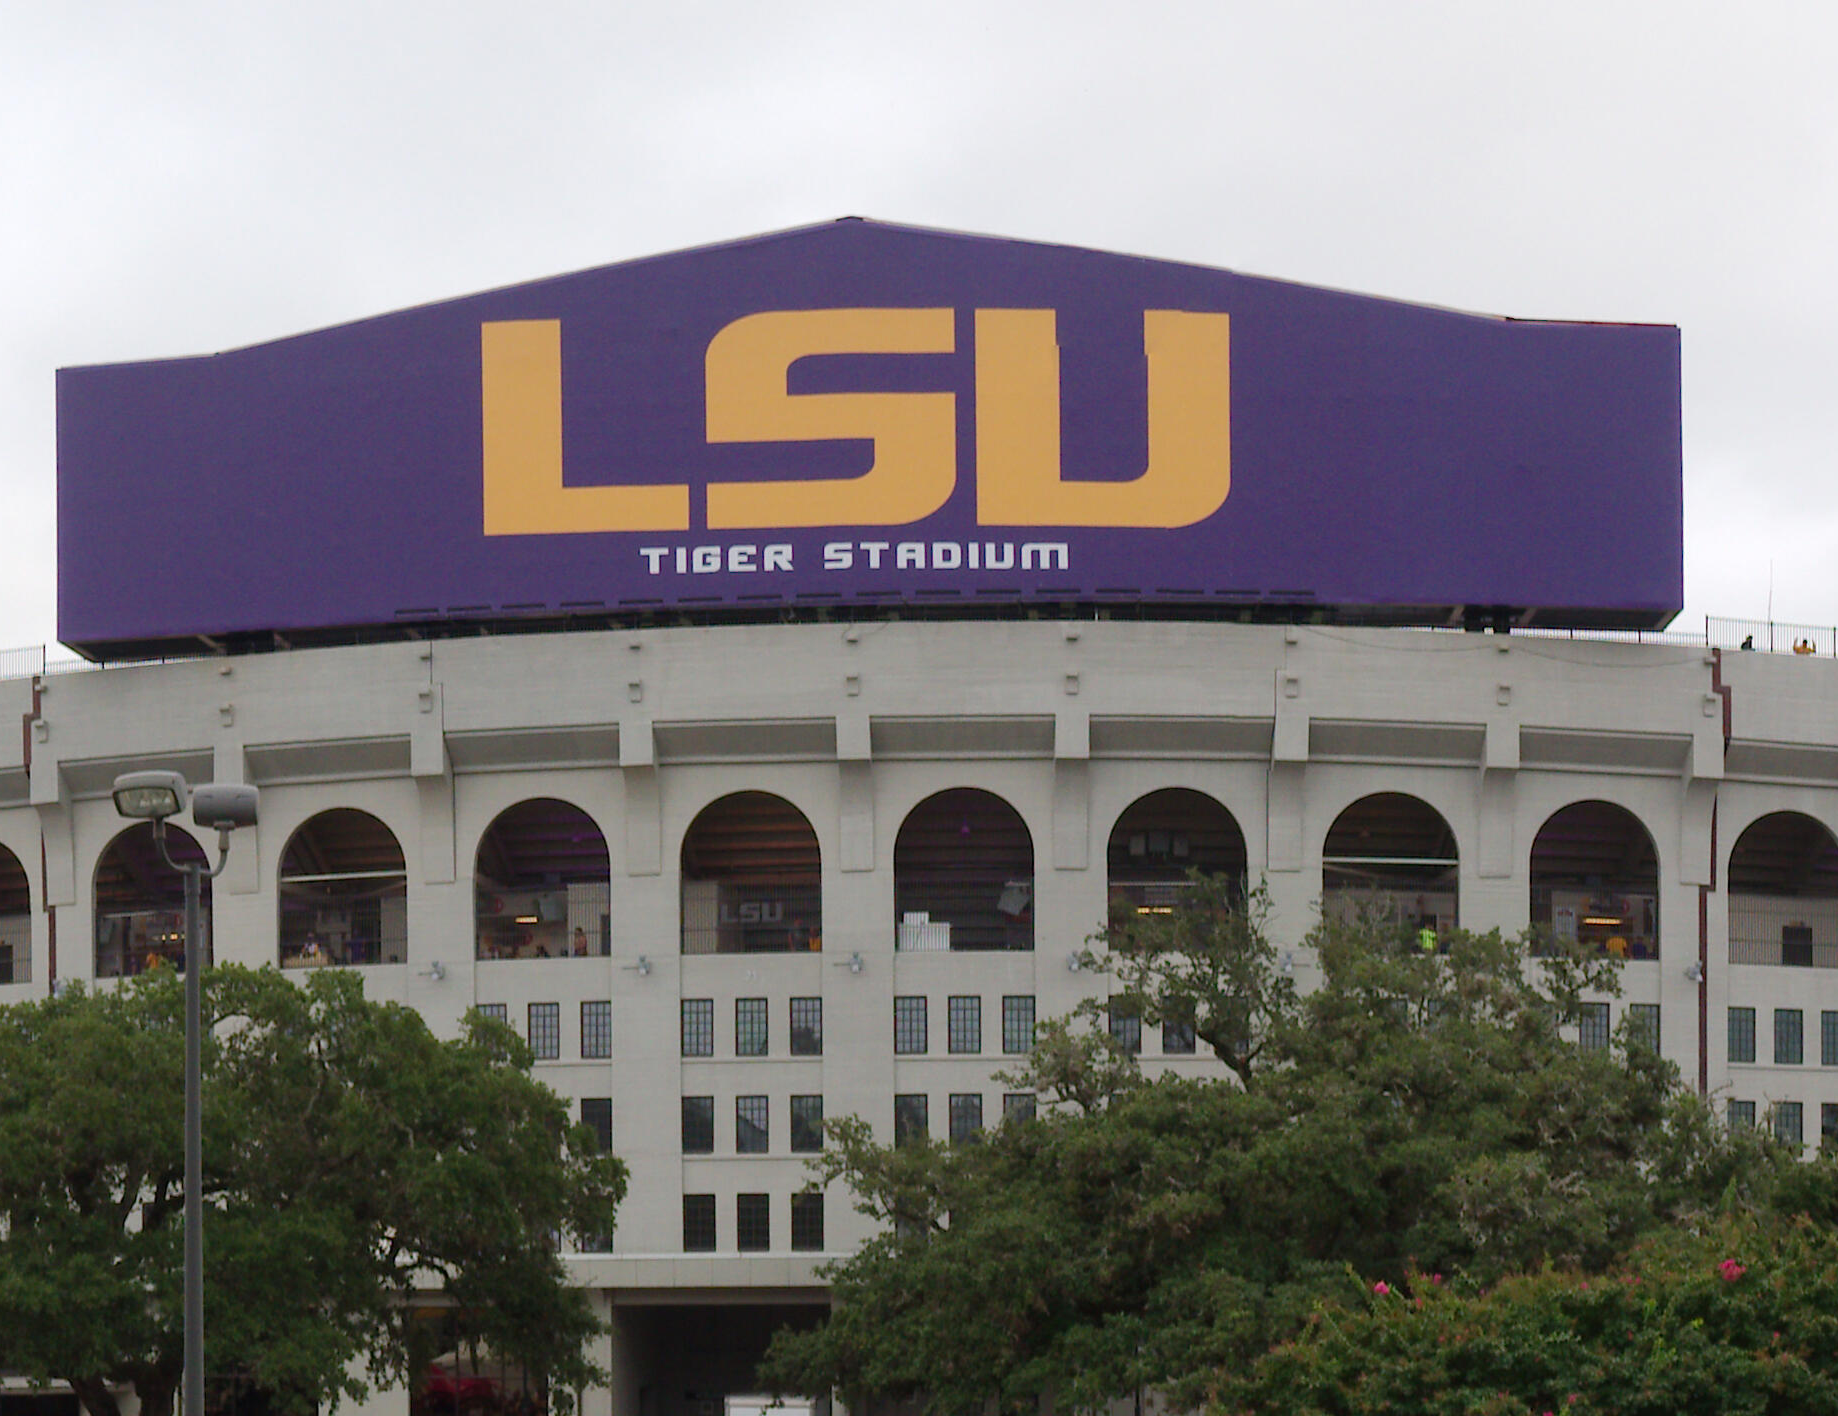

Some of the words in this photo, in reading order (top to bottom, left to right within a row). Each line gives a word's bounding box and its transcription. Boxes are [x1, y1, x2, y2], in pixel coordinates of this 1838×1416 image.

[481, 307, 1230, 536] LSU
[640, 544, 794, 575] TIGER
[824, 541, 1069, 570] STADIUM
